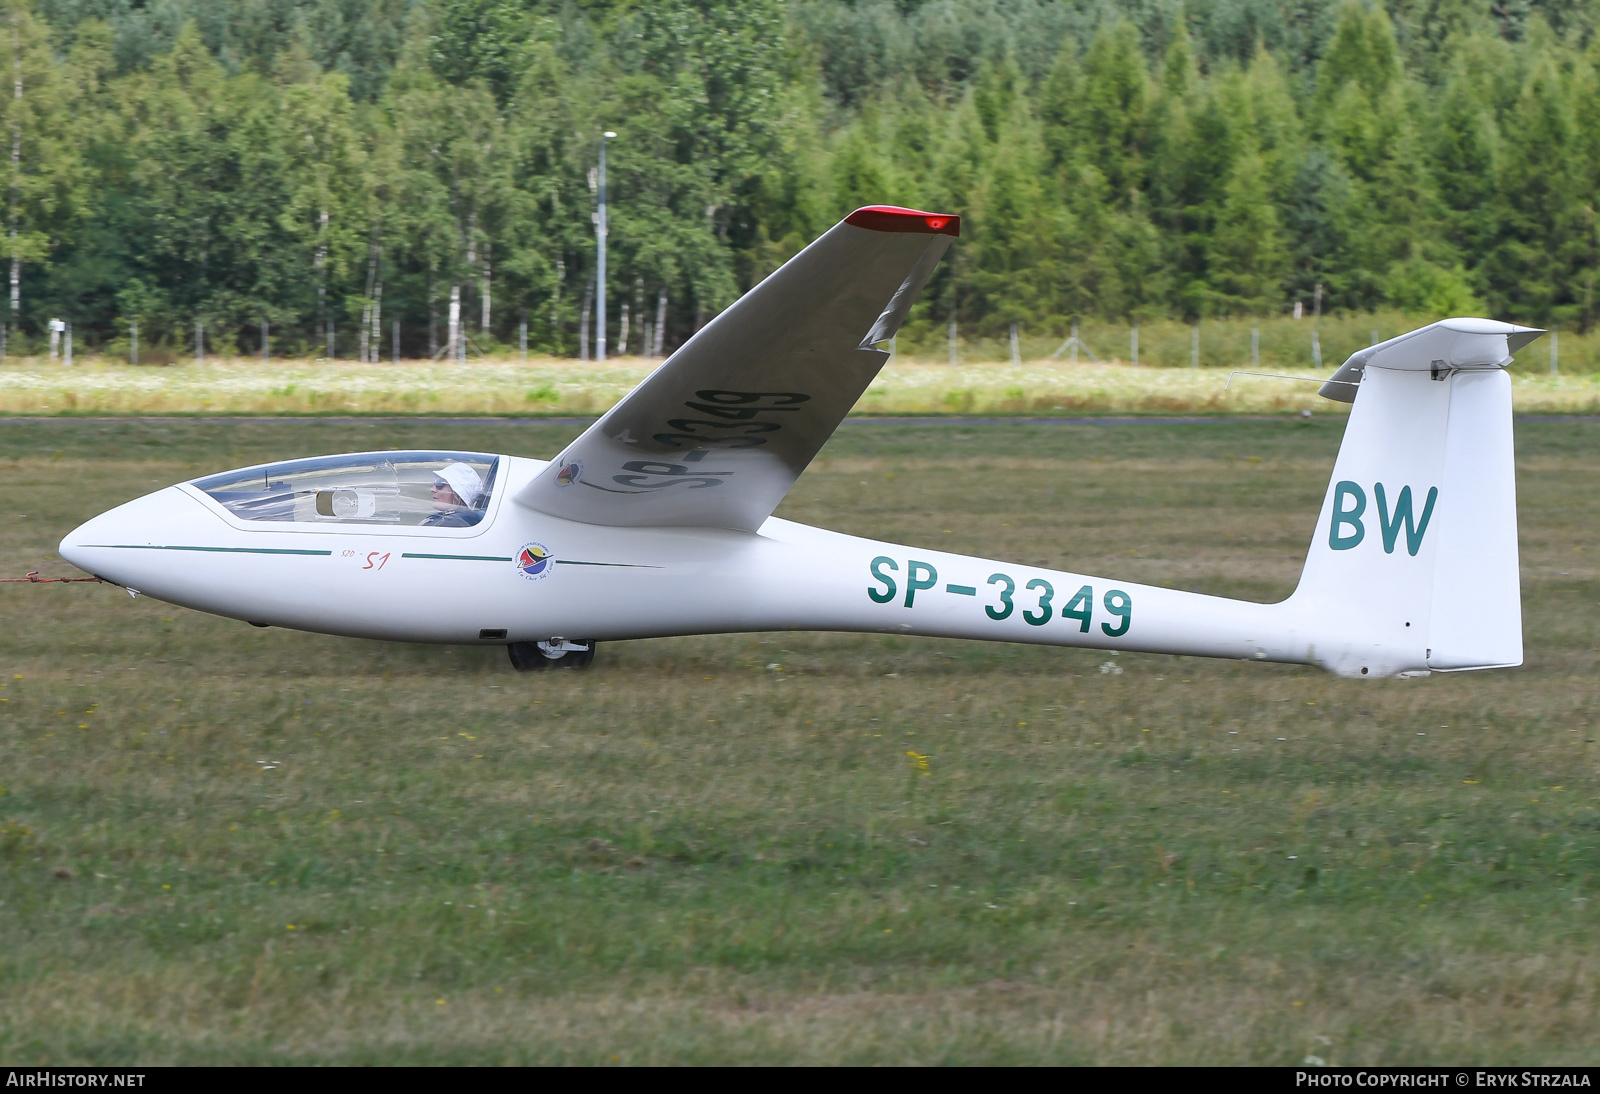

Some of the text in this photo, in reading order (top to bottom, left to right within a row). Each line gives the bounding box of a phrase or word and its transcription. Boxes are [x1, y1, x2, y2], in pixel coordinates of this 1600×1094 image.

[612, 390, 812, 489] SP-3349
[1329, 480, 1438, 557] BW
[868, 556, 1132, 637] SP-3349
